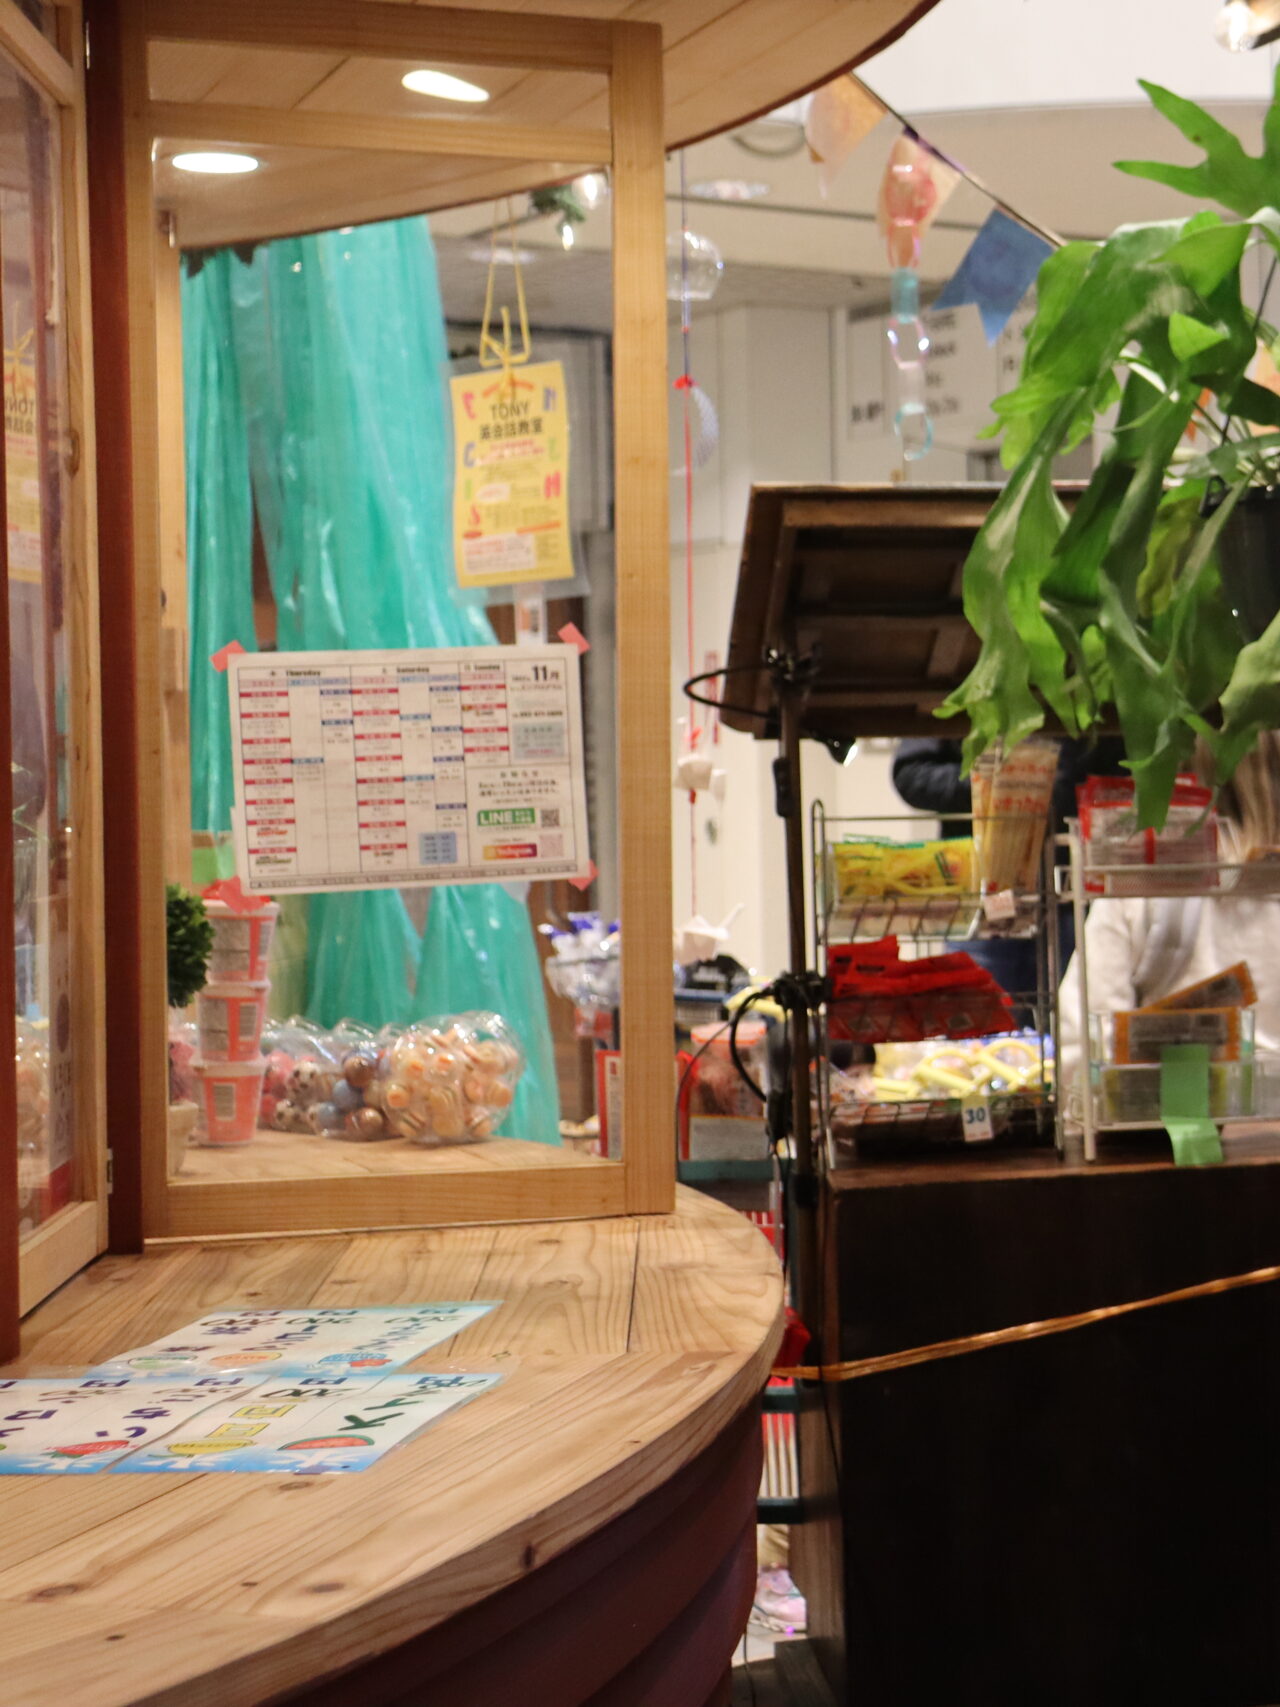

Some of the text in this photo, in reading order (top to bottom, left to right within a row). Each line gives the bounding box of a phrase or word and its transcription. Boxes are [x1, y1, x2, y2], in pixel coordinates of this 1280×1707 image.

[490, 402, 529, 420] TONY
[480, 810, 513, 825] LINE
[964, 1107, 987, 1124] 30
[79, 1379, 131, 1388] 円
[194, 1378, 244, 1387] 円
[299, 1377, 349, 1386] 円
[260, 1387, 362, 1399] 200
[95, 1393, 207, 1439] いちご
